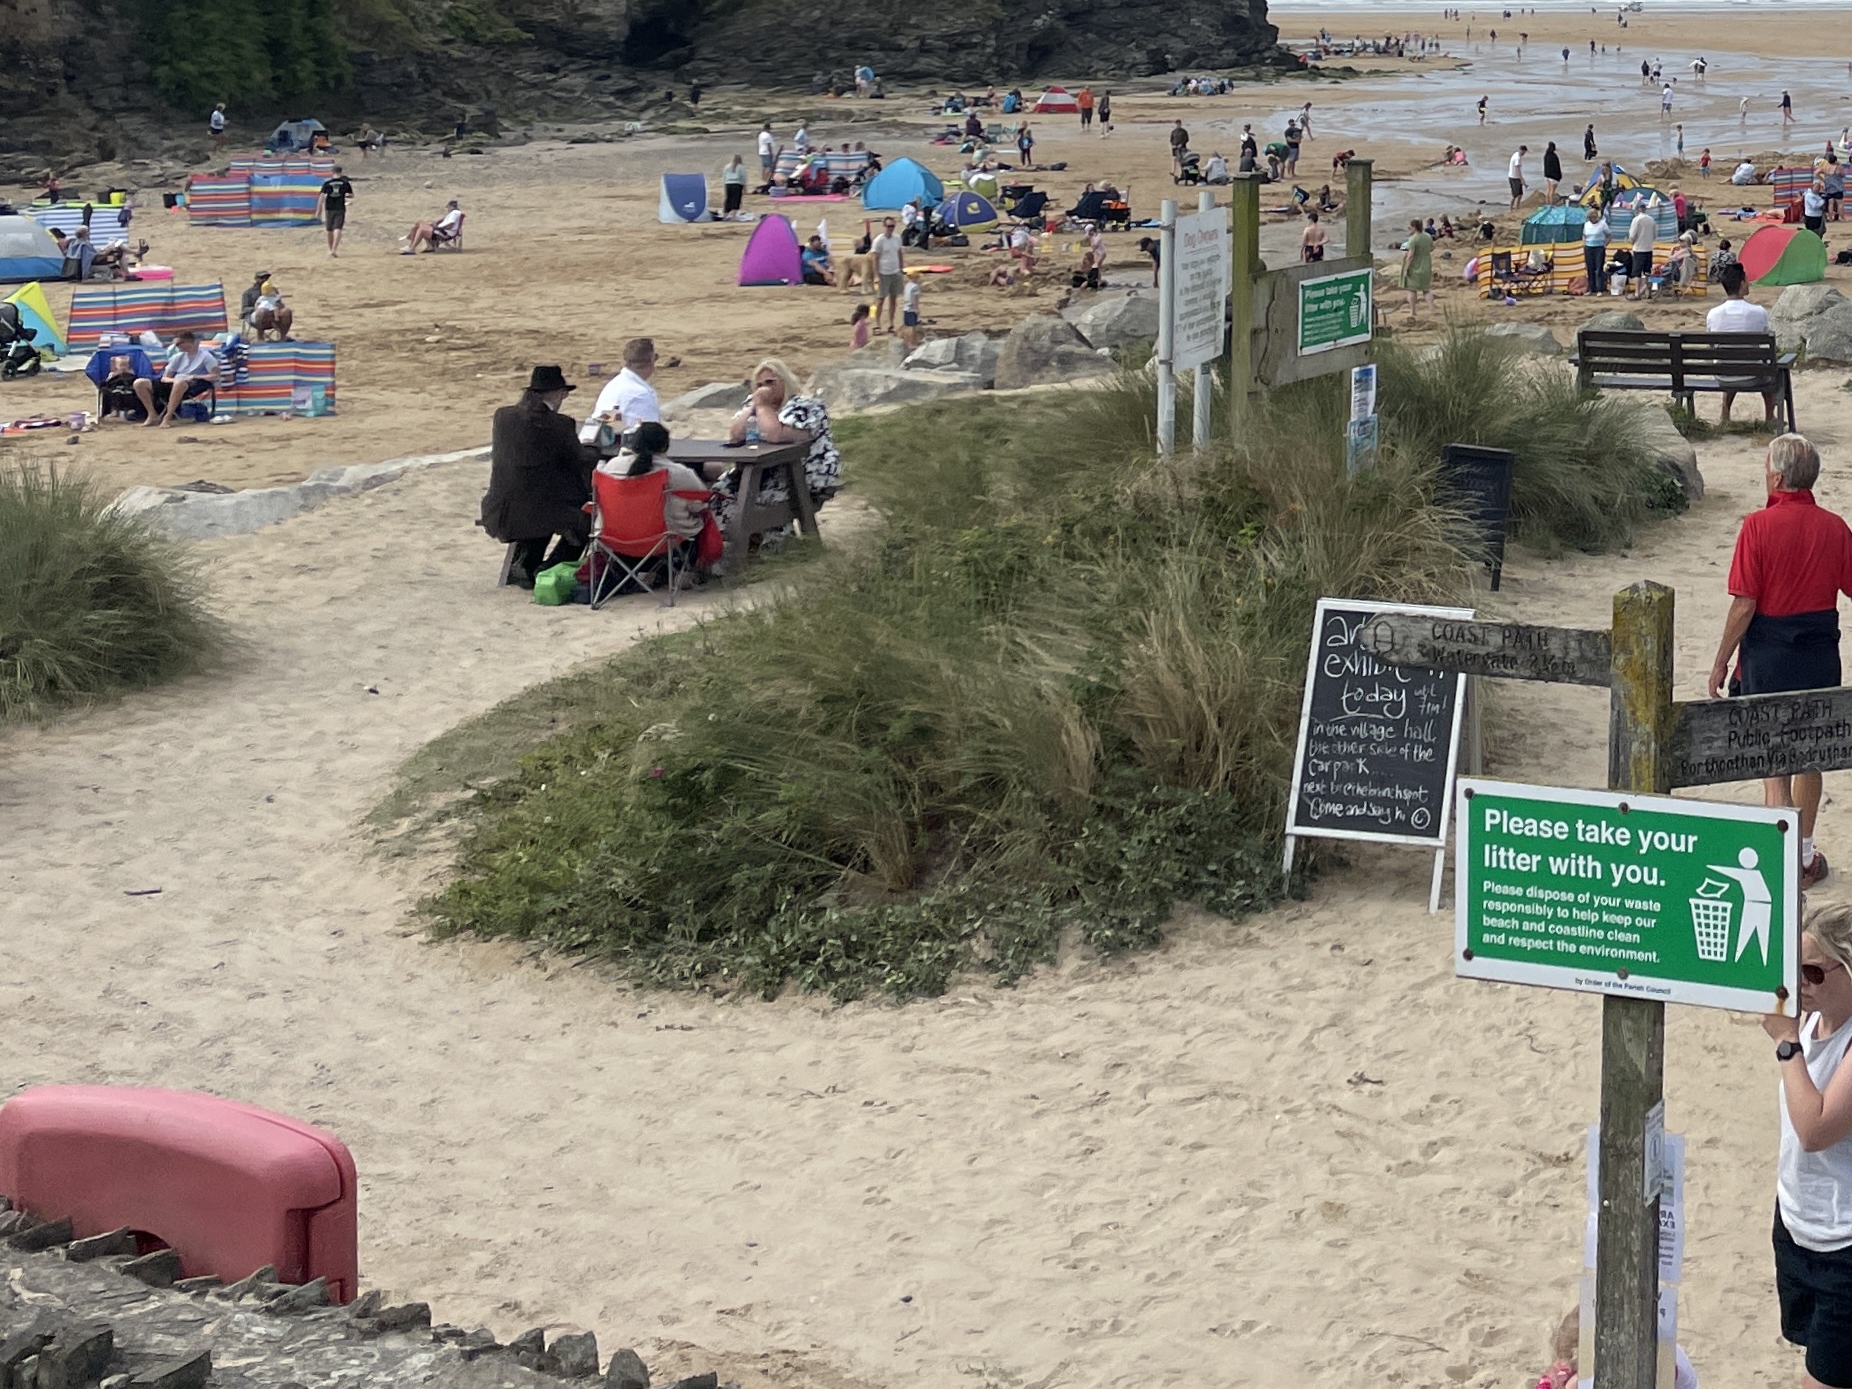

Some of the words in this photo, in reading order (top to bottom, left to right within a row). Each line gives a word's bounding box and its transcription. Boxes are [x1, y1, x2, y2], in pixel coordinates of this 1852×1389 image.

[1304, 289, 1325, 300] Please
[1431, 621, 1489, 647] COAST
[1502, 625, 1550, 650] PATH
[1341, 680, 1407, 720] today
[1728, 704, 1779, 726] COAST
[1787, 698, 1833, 724] PATH
[1312, 723, 1325, 736] in
[1325, 722, 1347, 737] the
[1350, 721, 1396, 742] village
[1728, 729, 1771, 750] Public
[1309, 739, 1330, 757] the
[1331, 740, 1366, 756] other
[1369, 741, 1398, 757] side
[1399, 742, 1411, 761] of
[1412, 743, 1437, 763] the
[1303, 778, 1327, 796] next
[1309, 796, 1345, 821] Come
[1345, 800, 1368, 816] and
[1367, 802, 1392, 825] say
[1484, 808, 1569, 842] Please
[1575, 818, 1631, 846] take
[1638, 829, 1698, 855] your
[1483, 843, 1542, 872] litter
[1548, 851, 1602, 880] with
[1611, 863, 1666, 888] you.
[1483, 880, 1524, 898] Please
[1526, 885, 1575, 905] dispose
[1577, 891, 1591, 905] of
[1592, 894, 1622, 910] your
[1624, 896, 1661, 913] waste
[1483, 900, 1554, 921] responsibly
[1557, 907, 1570, 919] to
[1572, 908, 1600, 927] help
[1602, 911, 1632, 929] keep
[1634, 916, 1657, 929] our
[1483, 915, 1520, 931] beach
[1522, 919, 1546, 933] and
[1548, 921, 1605, 940] coastline
[1607, 928, 1640, 944] clean
[1482, 931, 1506, 946] and
[1508, 935, 1554, 954] respect
[1556, 938, 1577, 954] the
[1579, 943, 1661, 964] environment.
[1575, 977, 1584, 985] by
[1585, 978, 1602, 986] Order
[1604, 980, 1611, 988] of
[1612, 981, 1623, 989] the
[1624, 982, 1645, 992] Parish
[1646, 985, 1671, 994] Council
